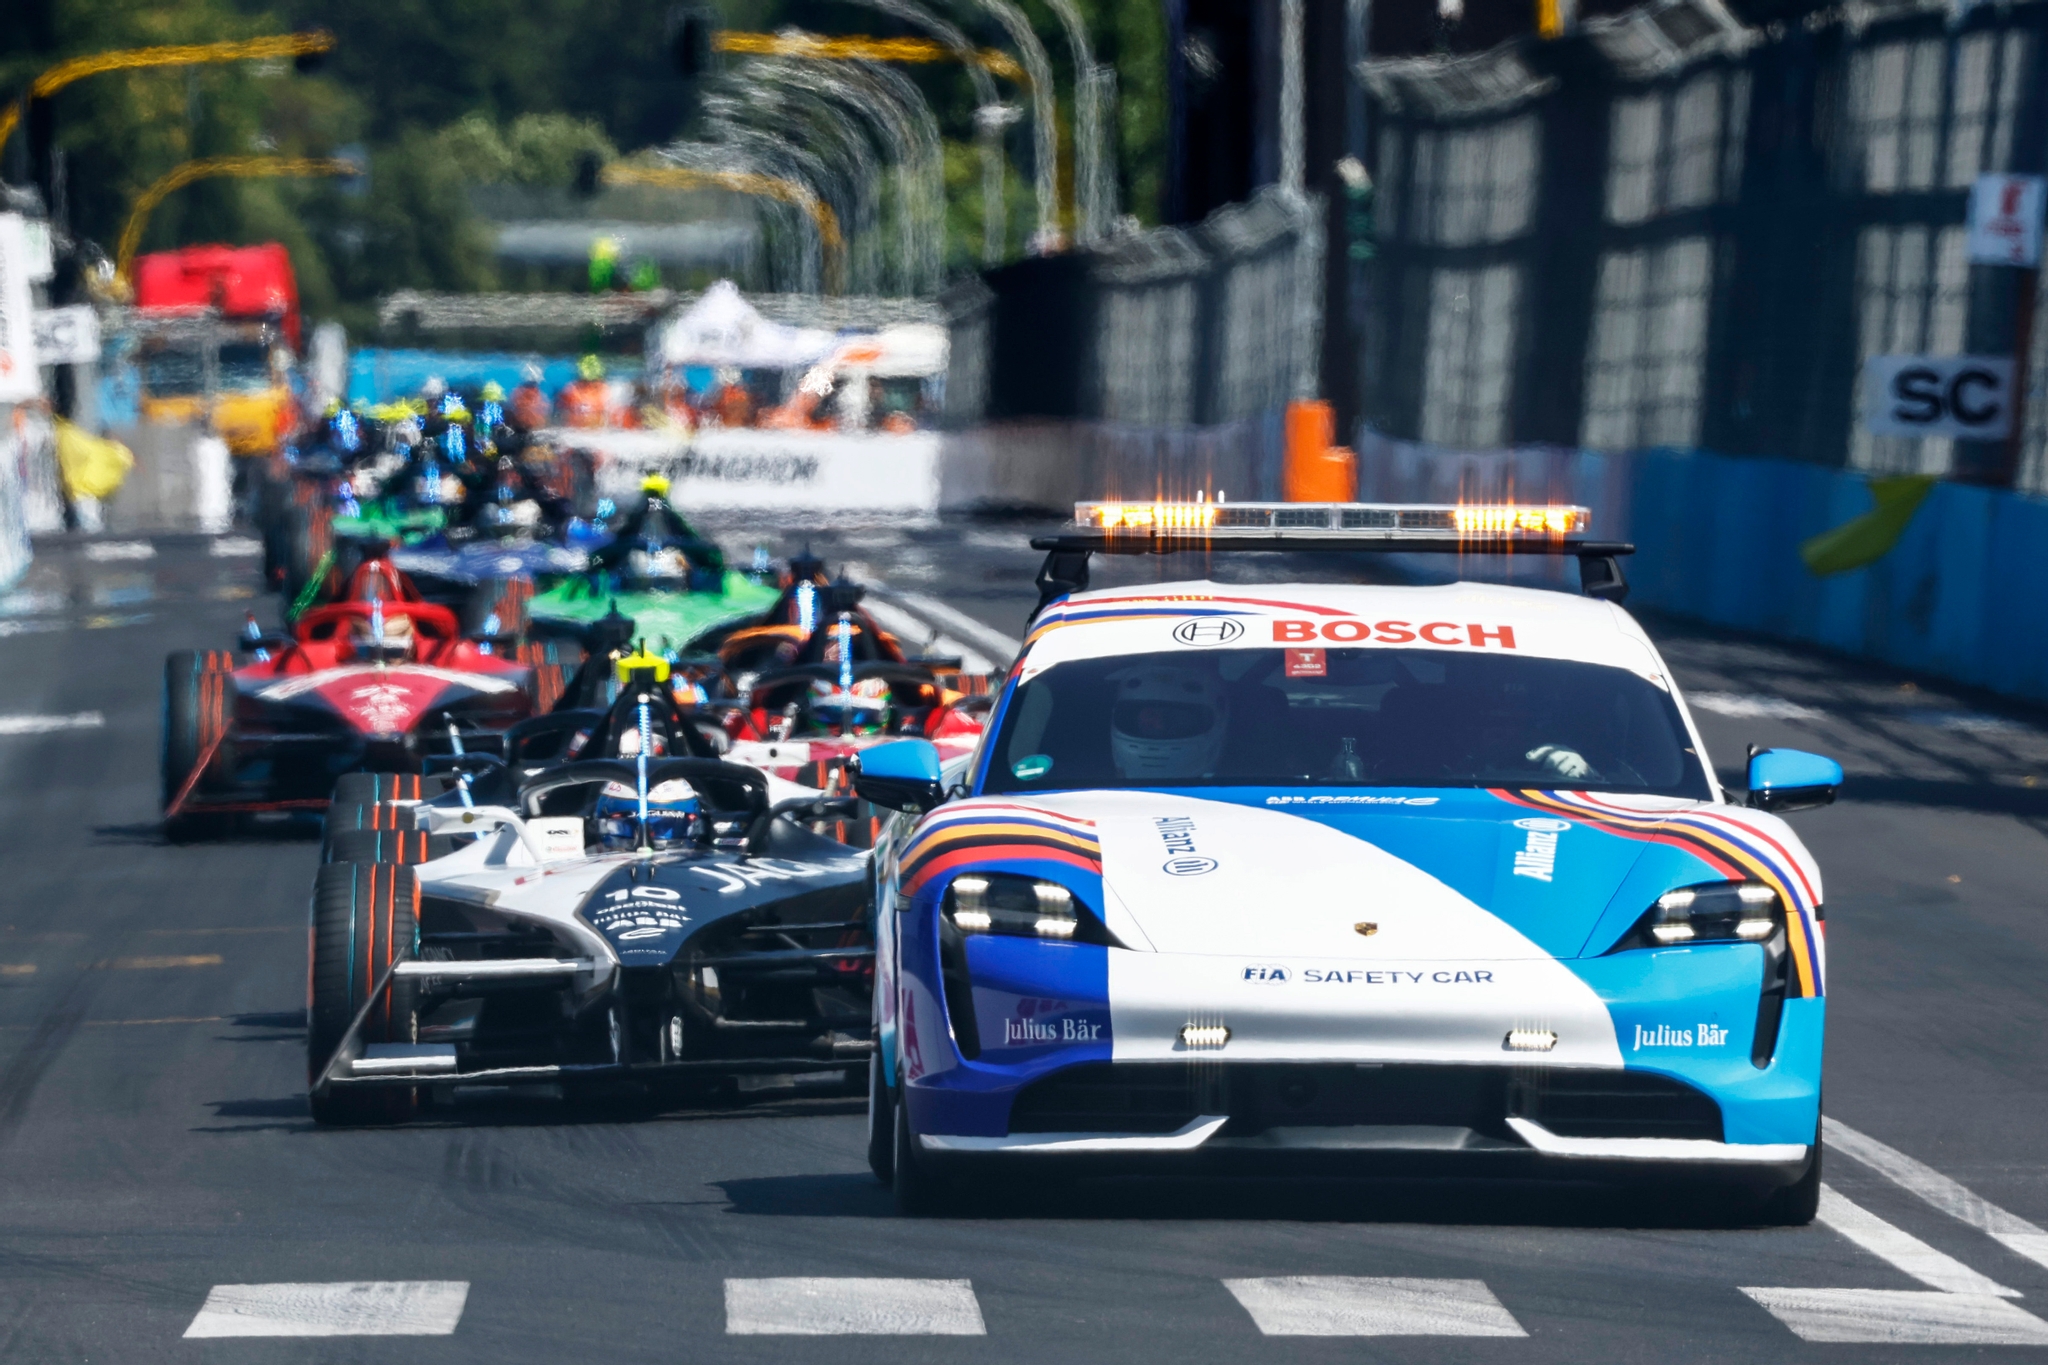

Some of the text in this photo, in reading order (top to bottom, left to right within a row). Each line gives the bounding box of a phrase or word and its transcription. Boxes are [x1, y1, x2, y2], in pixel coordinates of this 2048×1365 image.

[1892, 366, 2000, 425] SC
[1273, 620, 1516, 648] BOSCH
[1153, 817, 1196, 854] Allianz
[1513, 830, 1558, 882] Allianz
[605, 886, 681, 900] 10
[1304, 969, 1424, 984] SAFETY
[1432, 970, 1495, 984] CAR
[1004, 1018, 1102, 1045] Julius Bär
[1633, 1023, 1729, 1051] Julius Bär
